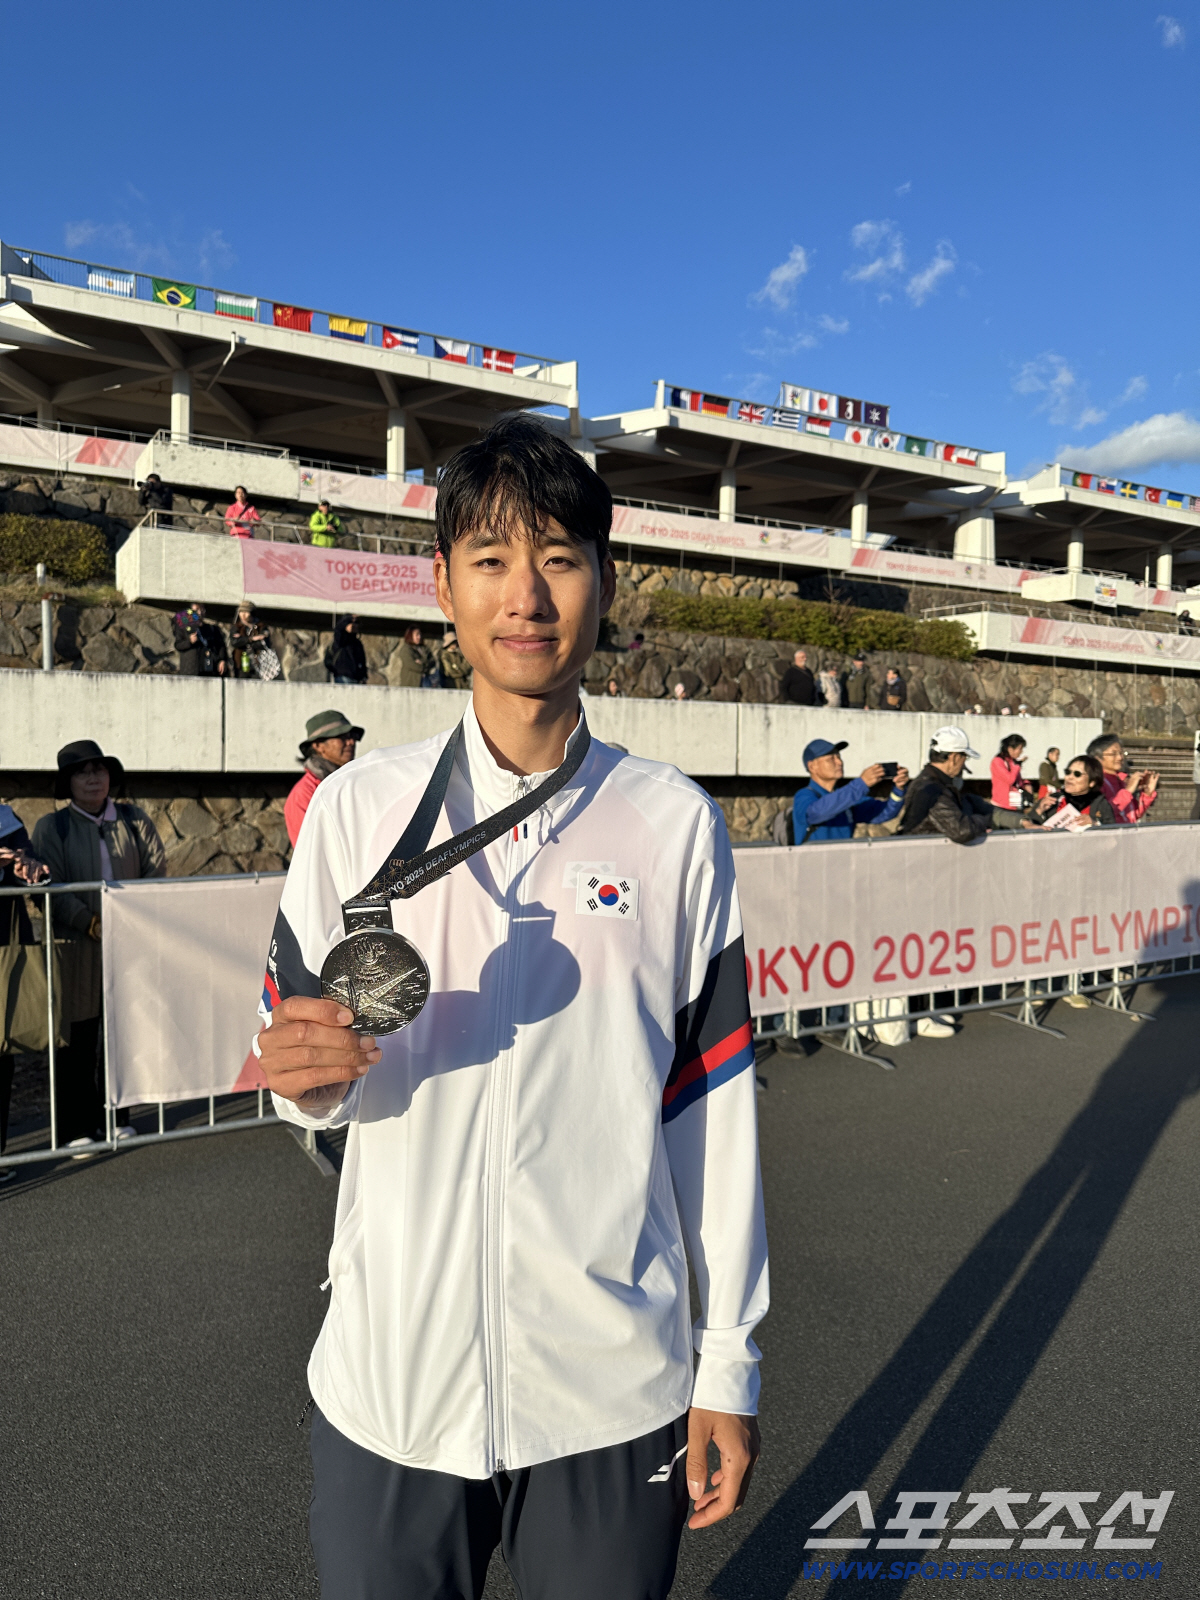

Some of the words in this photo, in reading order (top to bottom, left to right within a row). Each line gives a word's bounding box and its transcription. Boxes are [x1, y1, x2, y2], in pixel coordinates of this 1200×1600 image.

[325, 559, 377, 575] TOKYO
[383, 564, 418, 578] 2025
[404, 868, 425, 883] 2025
[425, 830, 487, 871] DEAFLYMPICS
[873, 928, 976, 983] 2025
[990, 904, 1200, 969] DEAFLYMPI
